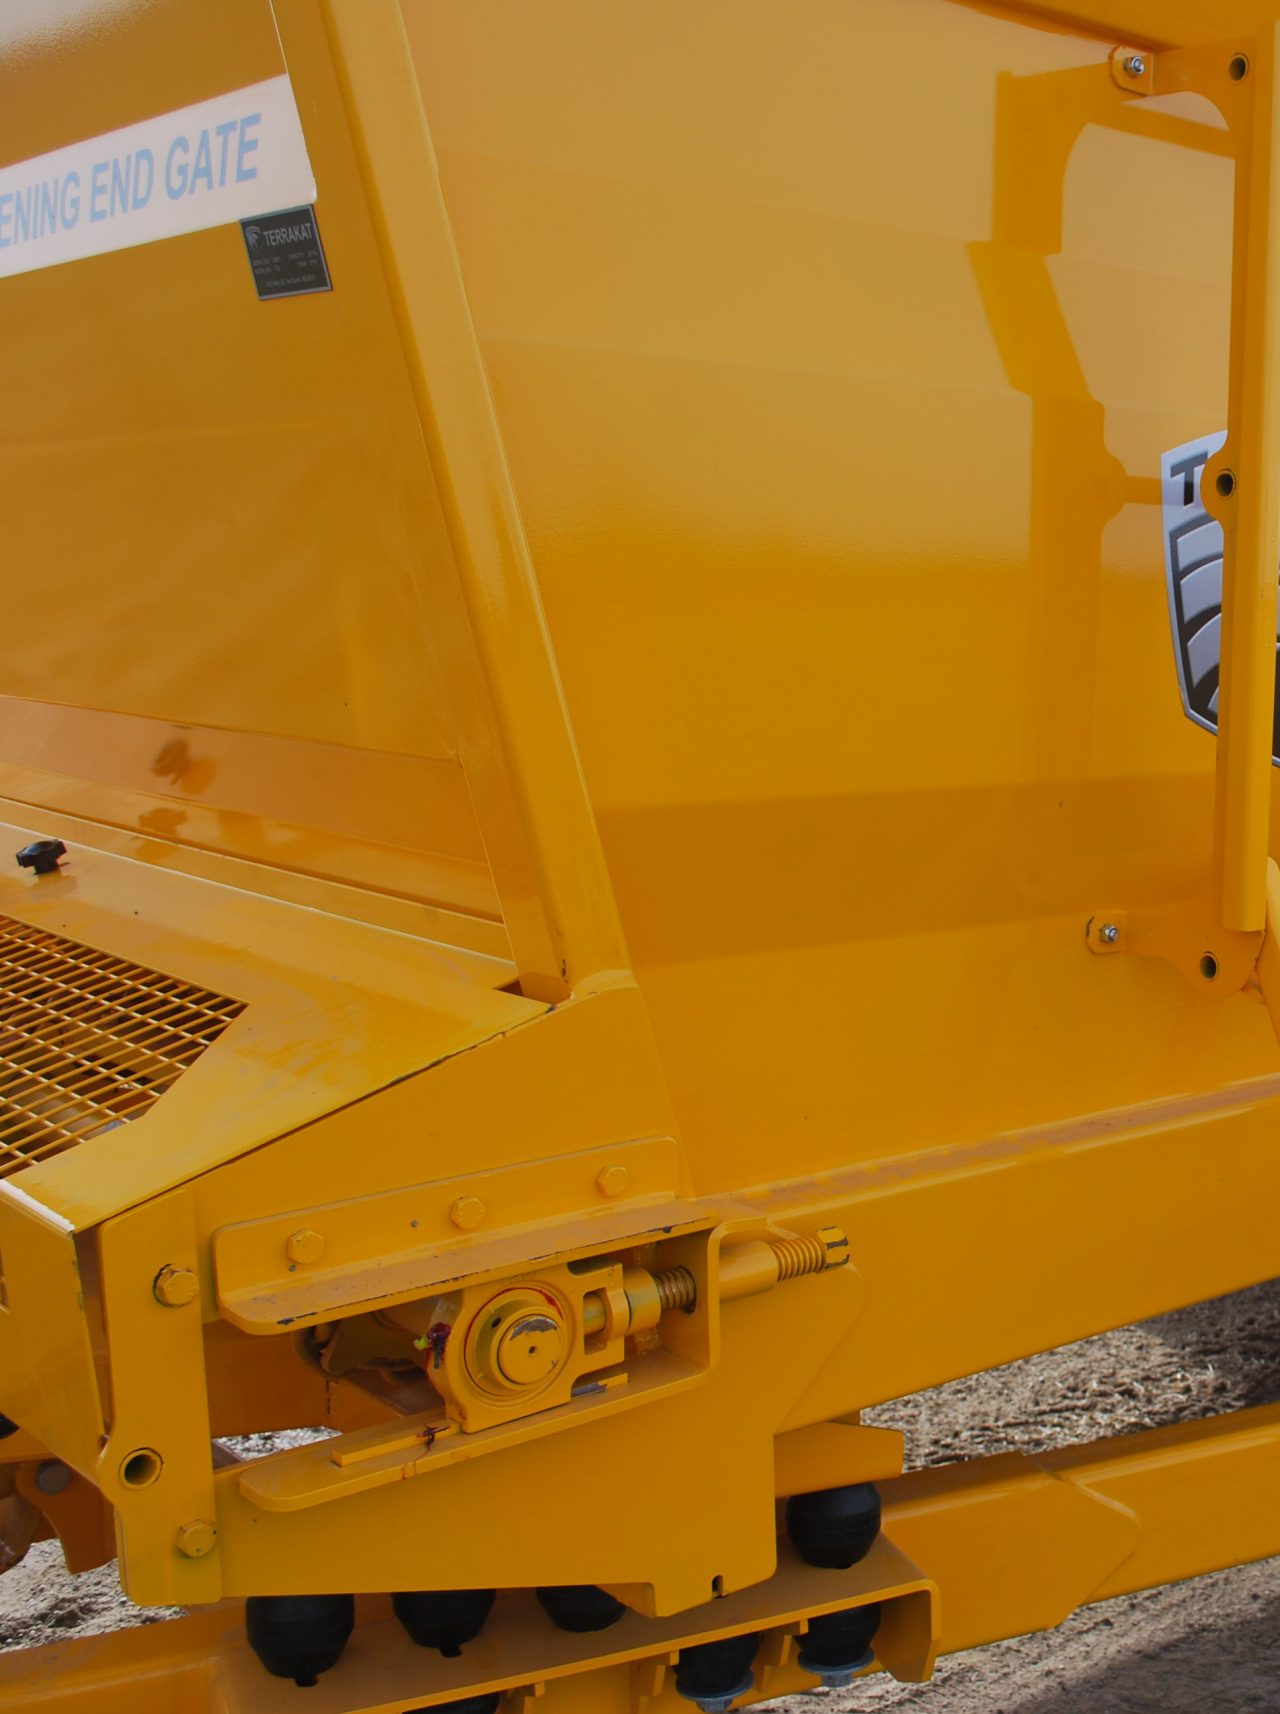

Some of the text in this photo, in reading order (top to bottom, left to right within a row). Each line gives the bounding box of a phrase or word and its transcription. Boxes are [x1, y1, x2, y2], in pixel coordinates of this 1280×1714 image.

[90, 148, 154, 222] END
[165, 114, 261, 200] GATE
[263, 223, 313, 247] TERRAKAT
